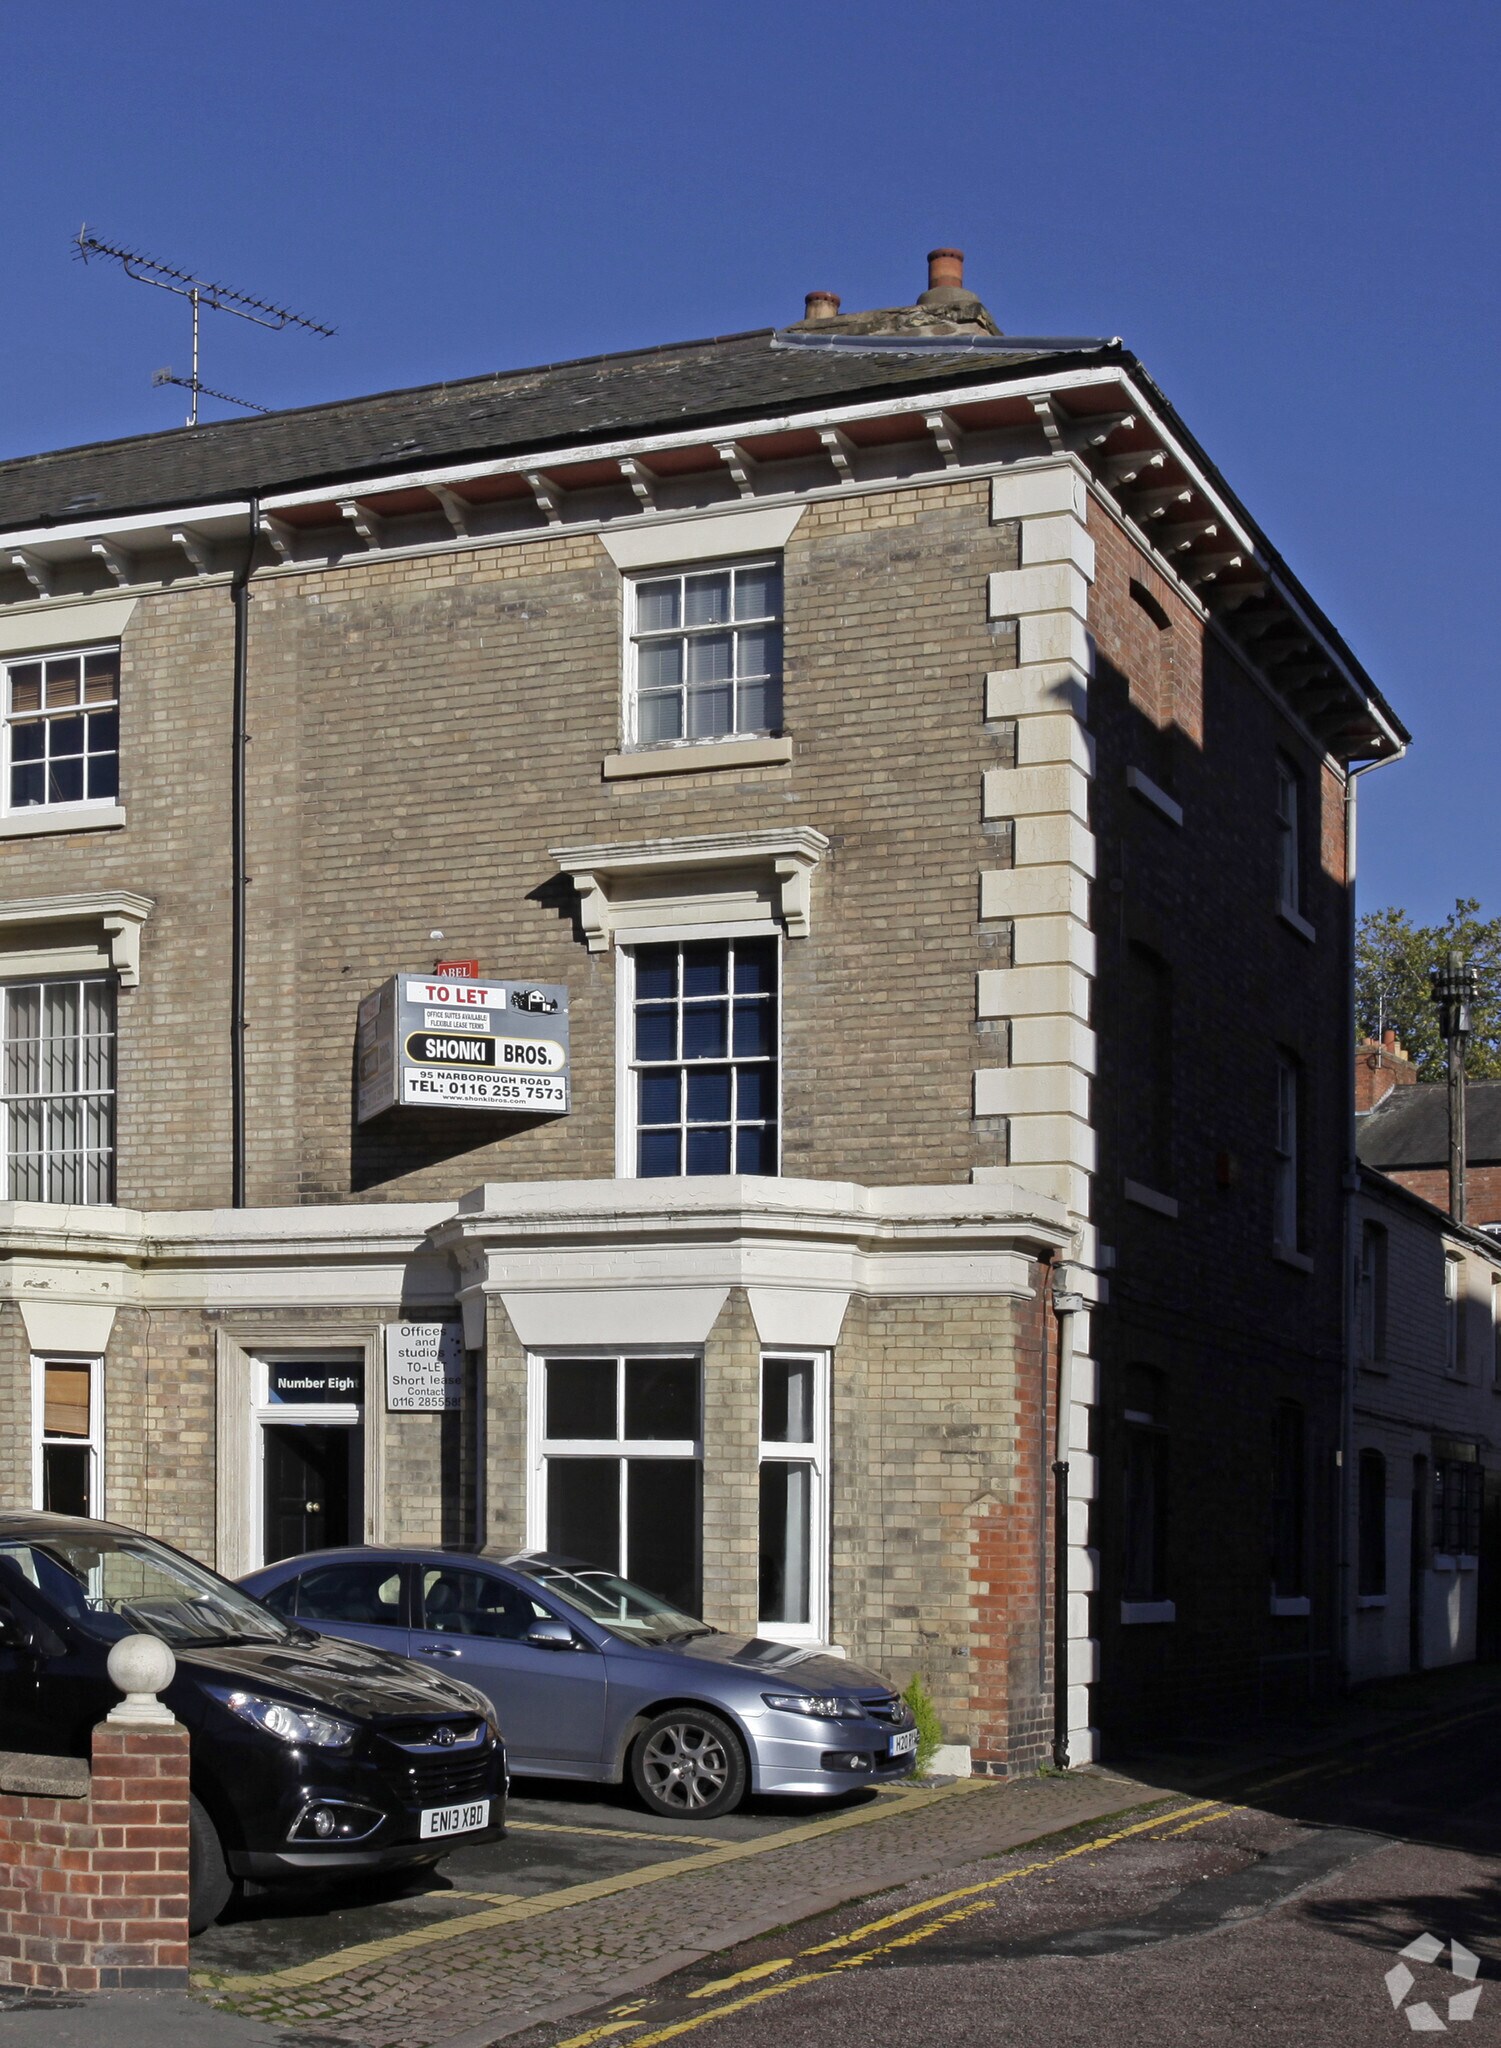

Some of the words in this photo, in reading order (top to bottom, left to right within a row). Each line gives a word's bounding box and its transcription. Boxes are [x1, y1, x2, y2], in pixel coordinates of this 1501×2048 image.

[441, 966, 470, 978] ABEL
[425, 985, 450, 1002] TO
[456, 988, 488, 1005] LET
[444, 1012, 461, 1020] SUITES
[430, 1020, 452, 1028] FLEXIBLE
[453, 1021, 467, 1029] LEASE
[425, 1038, 486, 1061] SHONKI
[504, 1044, 552, 1065] BROS.
[420, 1071, 433, 1079] 95
[437, 1072, 516, 1084] NARBOROUGH
[520, 1078, 551, 1086] ROAD
[409, 1080, 444, 1093] TEL:
[449, 1082, 487, 1096] 0116
[492, 1085, 520, 1098] 255
[526, 1087, 563, 1100] 7573
[443, 1095, 526, 1104] www.shonkibros.com
[400, 1326, 447, 1337] Offices
[415, 1338, 436, 1346] and
[398, 1347, 445, 1358] studios
[407, 1361, 447, 1372] TO-LET
[278, 1377, 325, 1389] Number
[328, 1377, 360, 1391] Eight
[392, 1375, 425, 1385] Short
[407, 1386, 445, 1396] Contact
[392, 1397, 414, 1407] 0116
[431, 1809, 459, 1833] EN13
[461, 1805, 483, 1828] XBD
